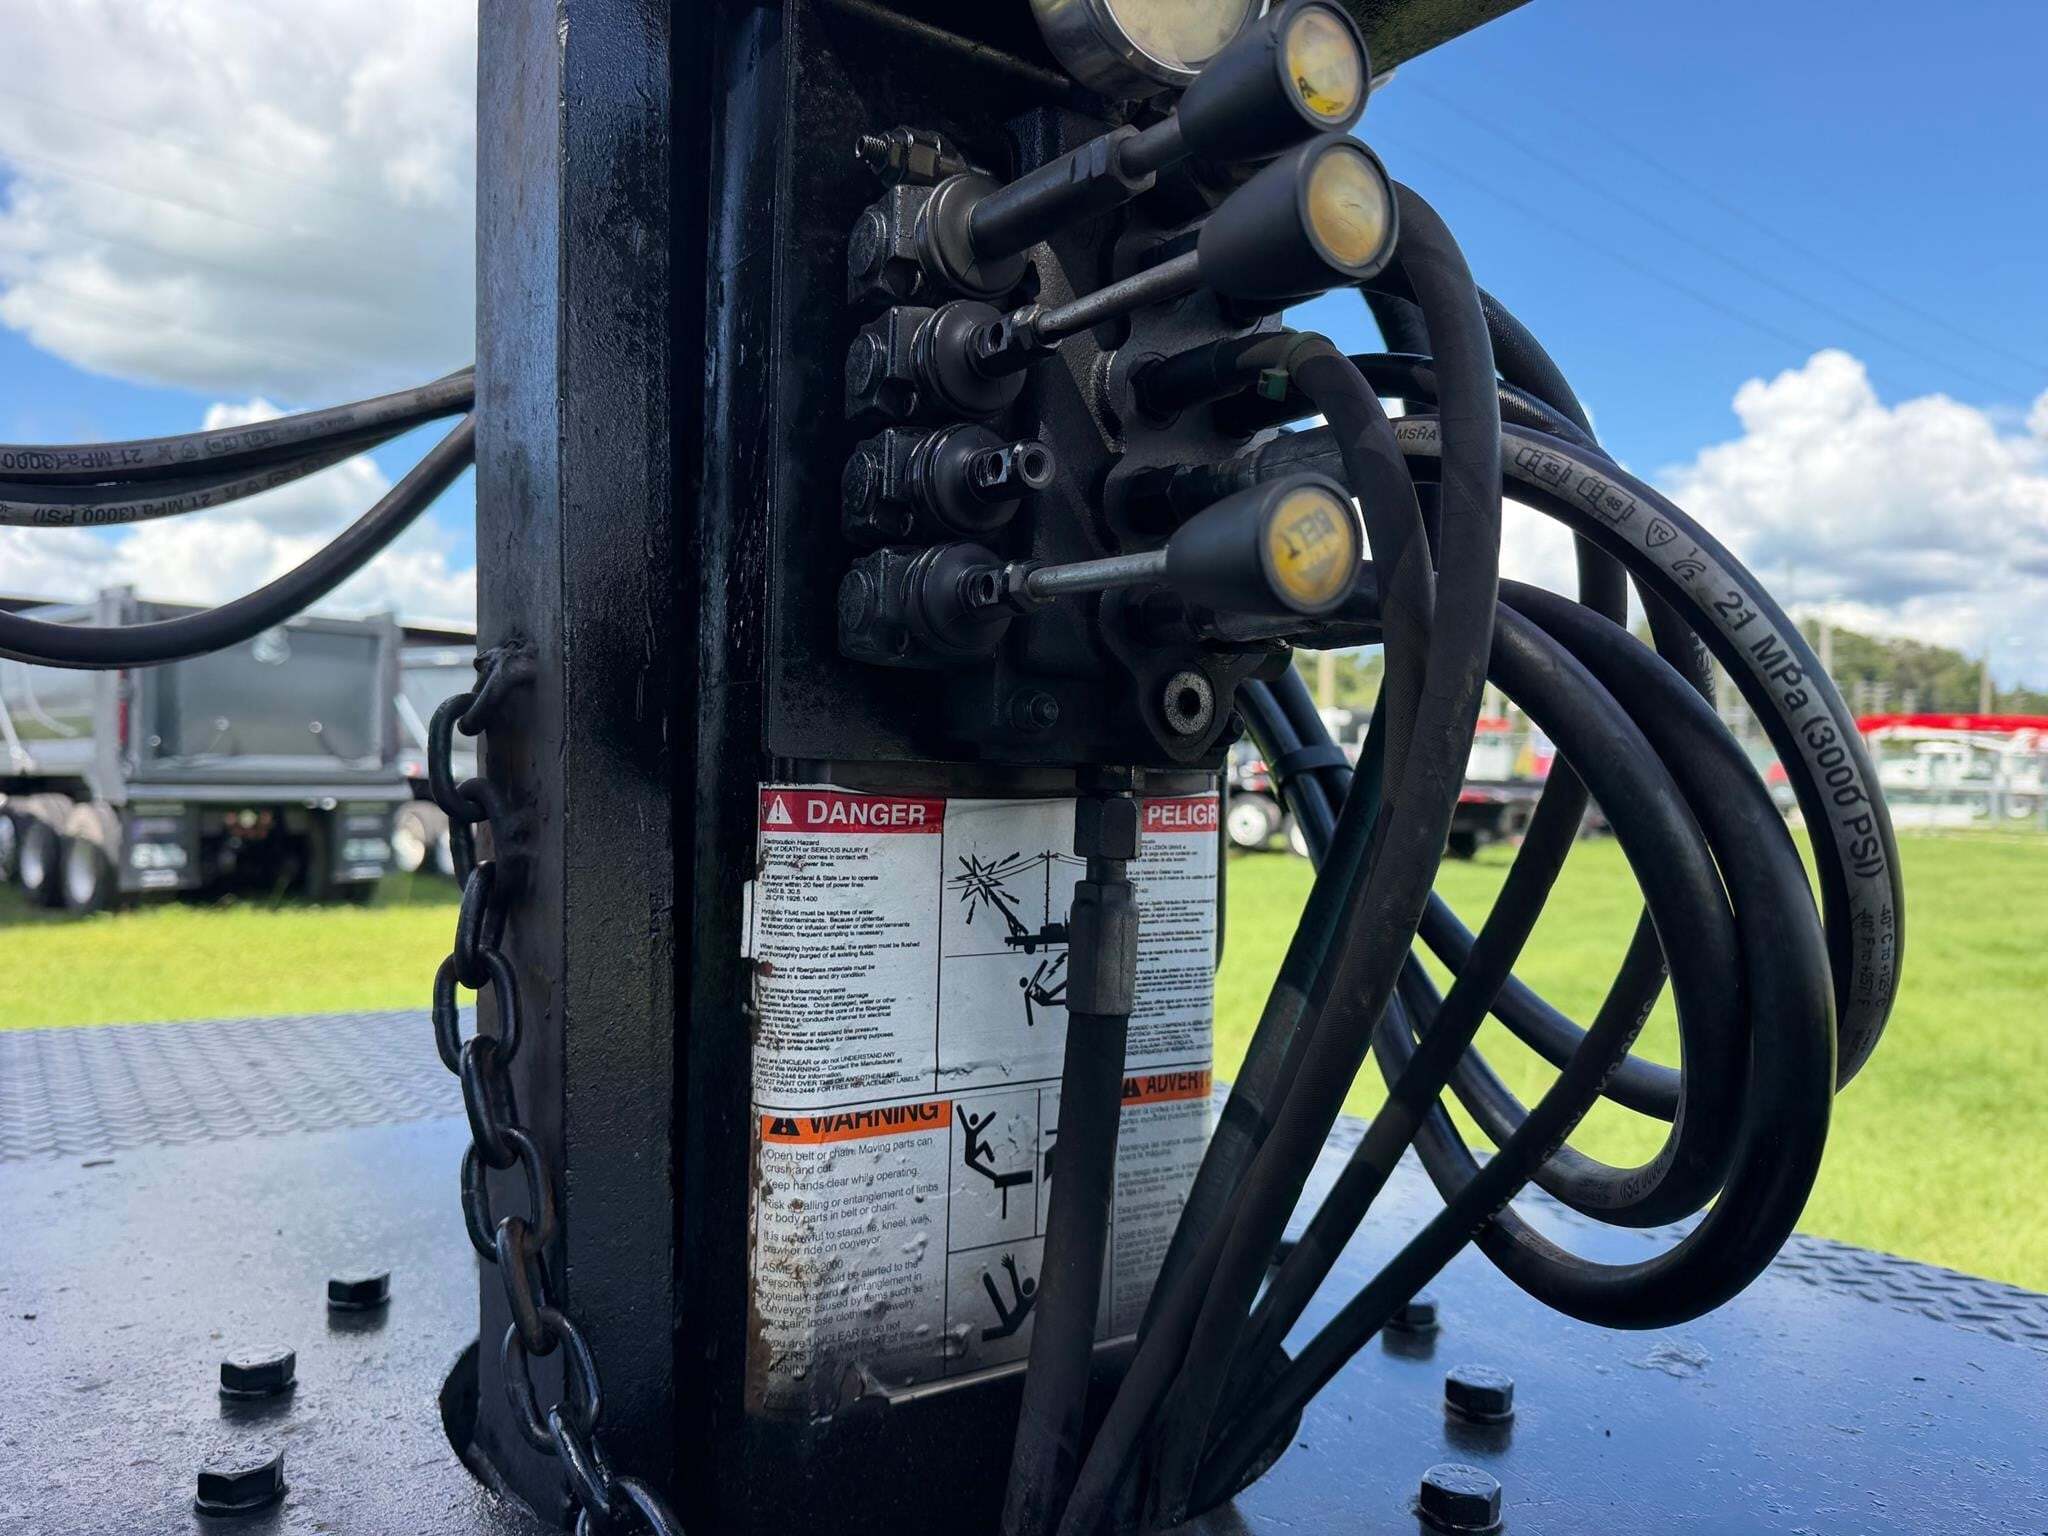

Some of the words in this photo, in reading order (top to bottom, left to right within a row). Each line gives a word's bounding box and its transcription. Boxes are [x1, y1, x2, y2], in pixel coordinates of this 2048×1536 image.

[1395, 428, 1437, 441] MSHA
[143, 498, 184, 516] MPa
[191, 492, 211, 507] 21
[33, 507, 75, 524] PSI)
[82, 505, 136, 523] (3000
[1713, 590, 1757, 632] 21
[1751, 632, 1809, 712] MPa
[1801, 714, 1863, 807] (3000
[1842, 811, 1885, 879] PSI)
[807, 799, 926, 826] DANGER
[840, 1051, 882, 1062] UNDERSTAND
[861, 1072, 880, 1080] OTHER
[810, 1103, 939, 1134] WARNING
[766, 1149, 793, 1161] Open
[795, 1150, 815, 1160] belt
[817, 1151, 828, 1159] or
[858, 1143, 891, 1154] Moving
[893, 1139, 915, 1152] parts
[916, 1137, 933, 1146] can
[765, 1164, 791, 1174] crush
[795, 1165, 815, 1174] and
[793, 1180, 824, 1191] hands
[826, 1177, 849, 1187] clear
[851, 1172, 874, 1185] while
[831, 1199, 841, 1207] or
[843, 1187, 904, 1205] entanglement
[905, 1184, 915, 1196] of
[916, 1183, 939, 1193] limbs
[764, 1212, 773, 1221] or
[775, 1212, 801, 1226] body
[802, 1212, 828, 1225] parts
[830, 1209, 839, 1219] in
[841, 1207, 858, 1219] belt
[859, 1206, 869, 1215] or
[826, 1231, 835, 1239] to
[803, 1245, 823, 1255] ride
[825, 1243, 837, 1252] on
[861, 1263, 892, 1278] alerted
[894, 1262, 903, 1272] to
[914, 1271, 922, 1281] in
[760, 1302, 812, 1316] conveyors
[850, 1297, 861, 1308] by
[890, 1286, 911, 1297] such
[807, 1316, 834, 1328] loose
